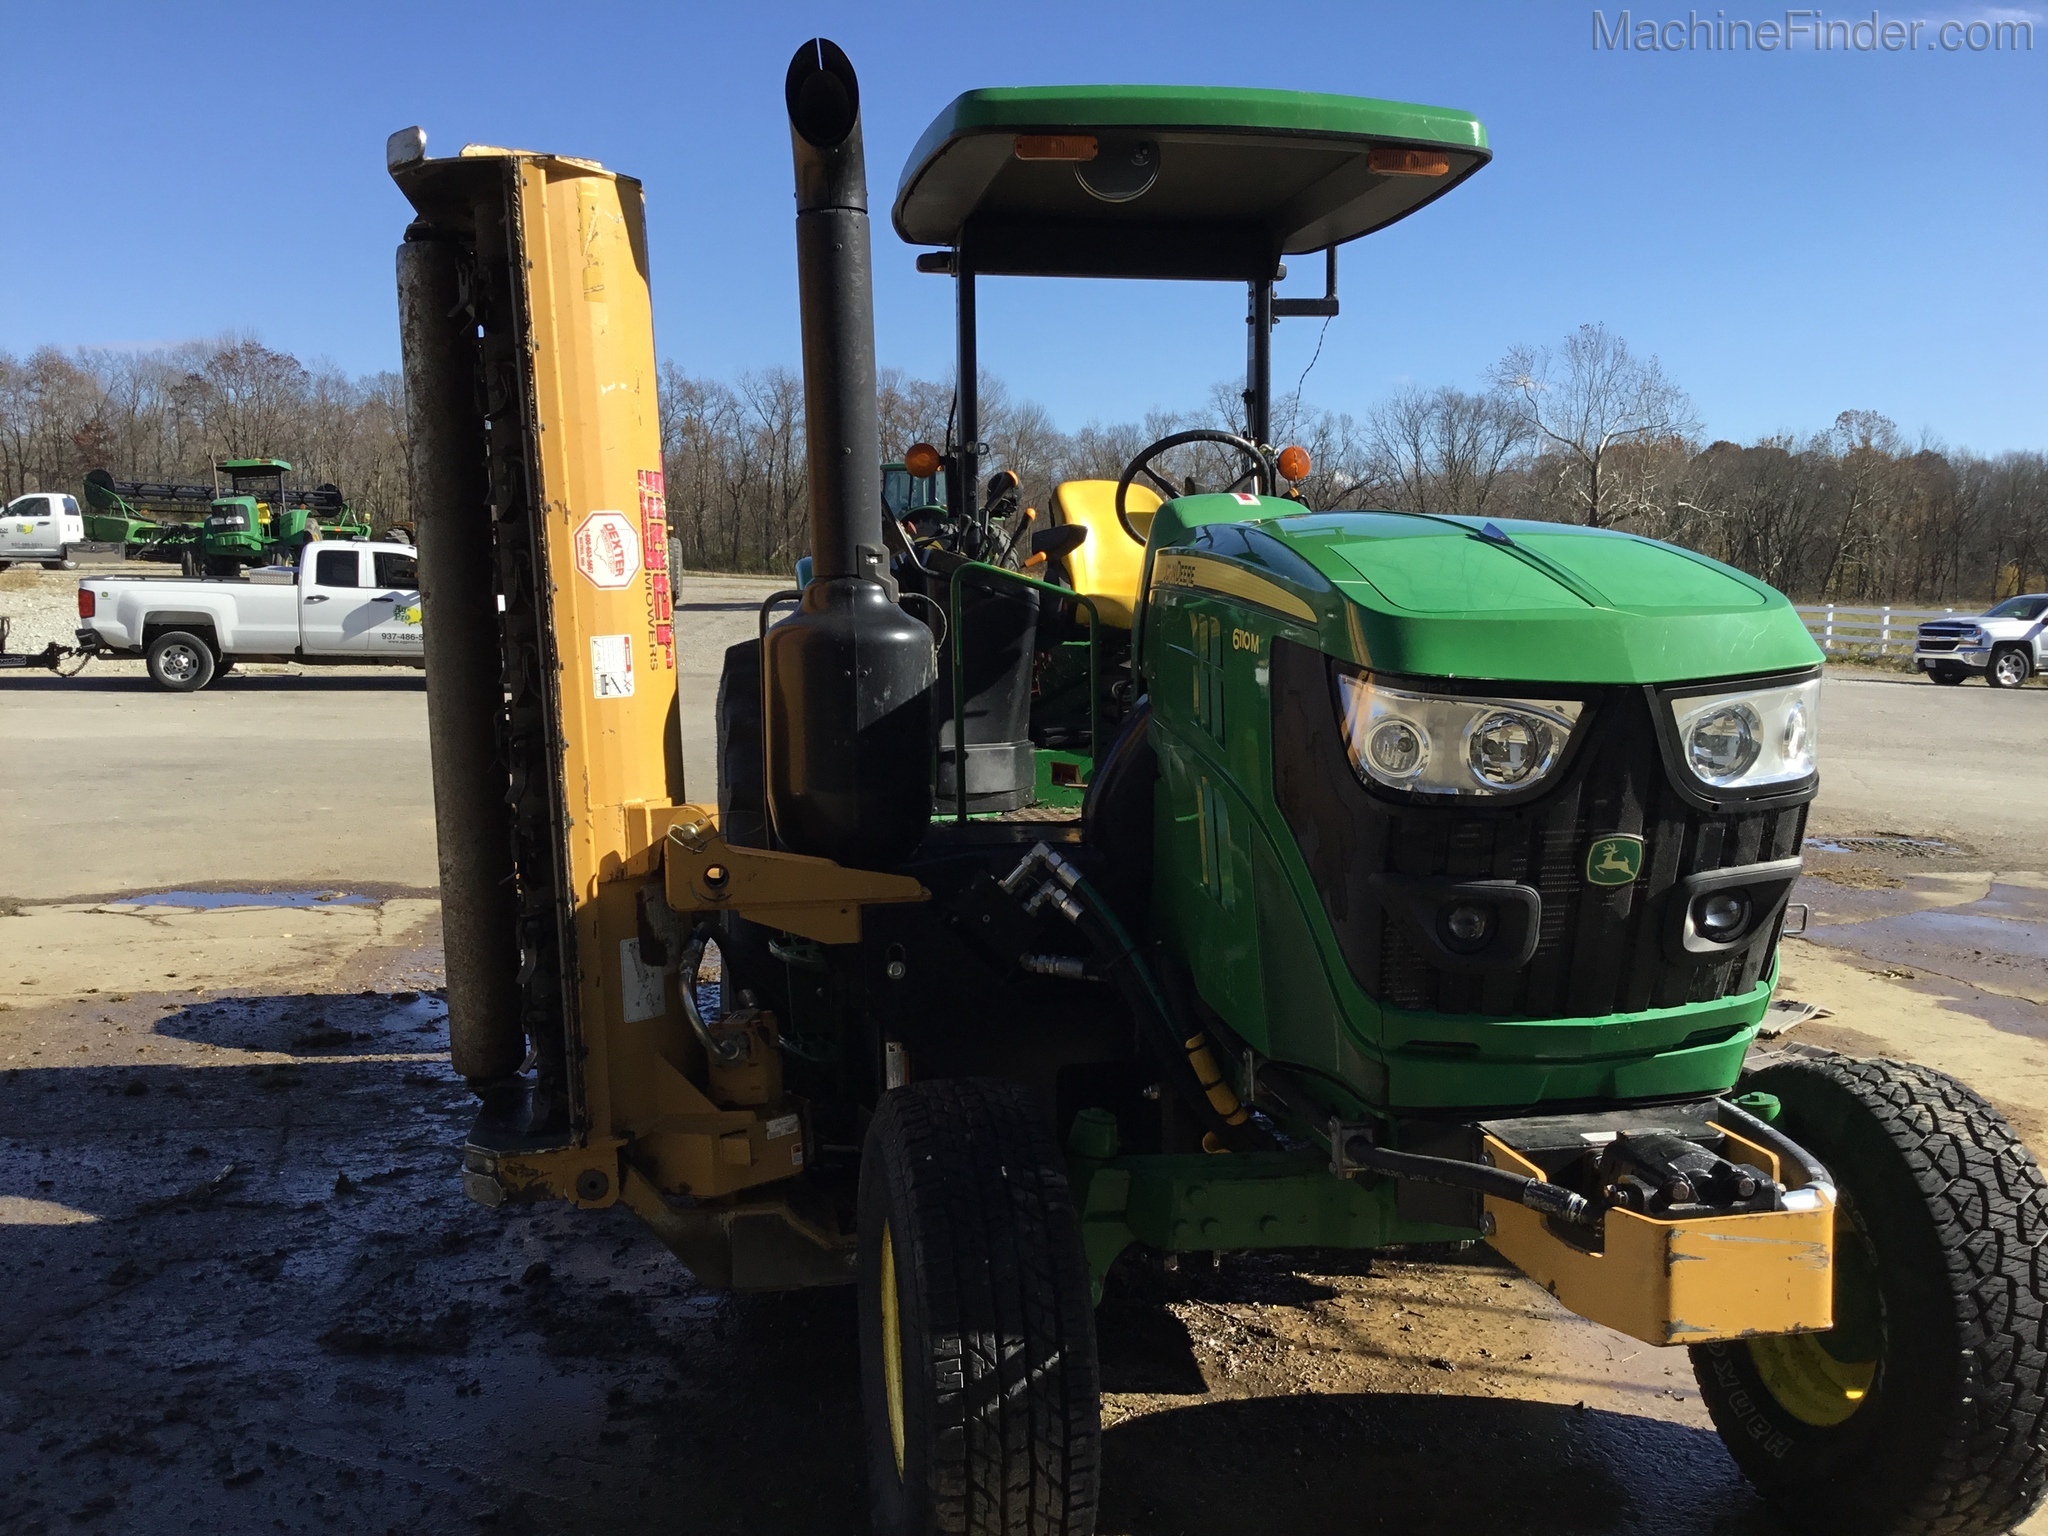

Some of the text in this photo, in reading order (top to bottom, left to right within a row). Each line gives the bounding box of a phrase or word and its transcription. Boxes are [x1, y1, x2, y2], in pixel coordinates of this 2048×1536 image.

[603, 523, 625, 577] DEXTER
[1175, 561, 1196, 587] DEERE
[394, 612, 411, 621] Pro
[644, 572, 658, 671] MOWERS
[1232, 628, 1260, 654] 6110M
